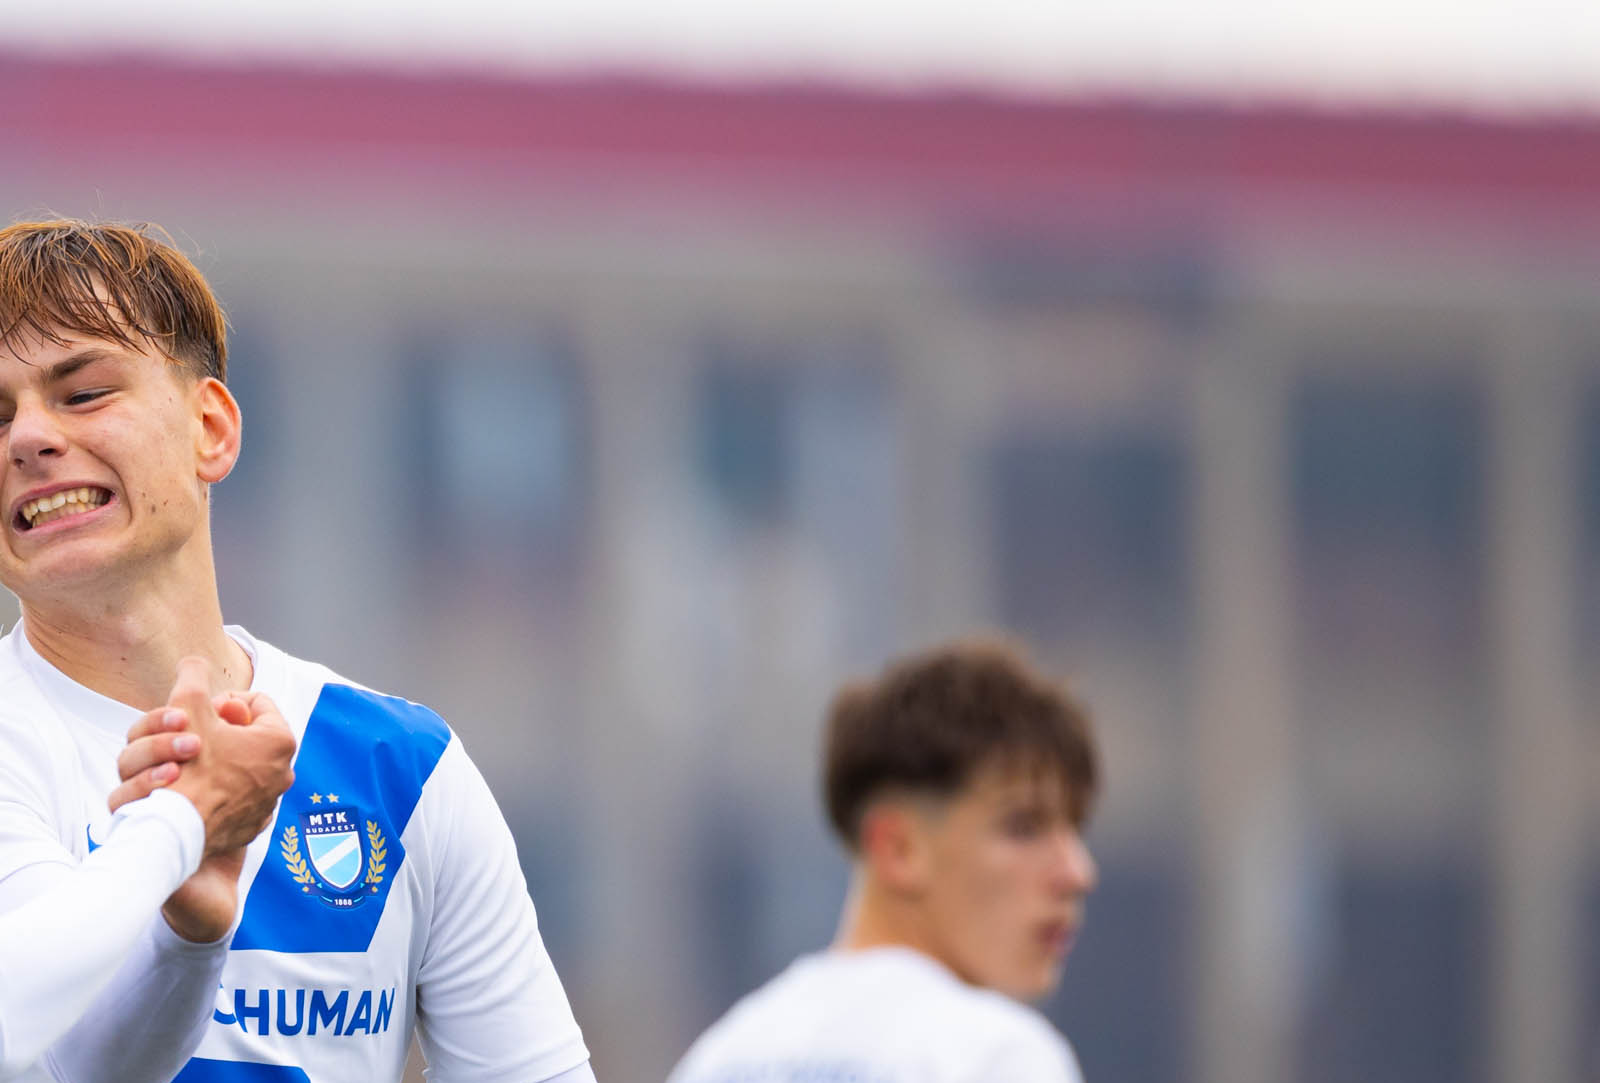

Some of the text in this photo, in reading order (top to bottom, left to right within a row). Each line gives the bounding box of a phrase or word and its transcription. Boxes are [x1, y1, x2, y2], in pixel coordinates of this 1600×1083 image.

[308, 811, 348, 826] MTK
[305, 824, 356, 834] BUDAPEST
[334, 898, 353, 906] 1888
